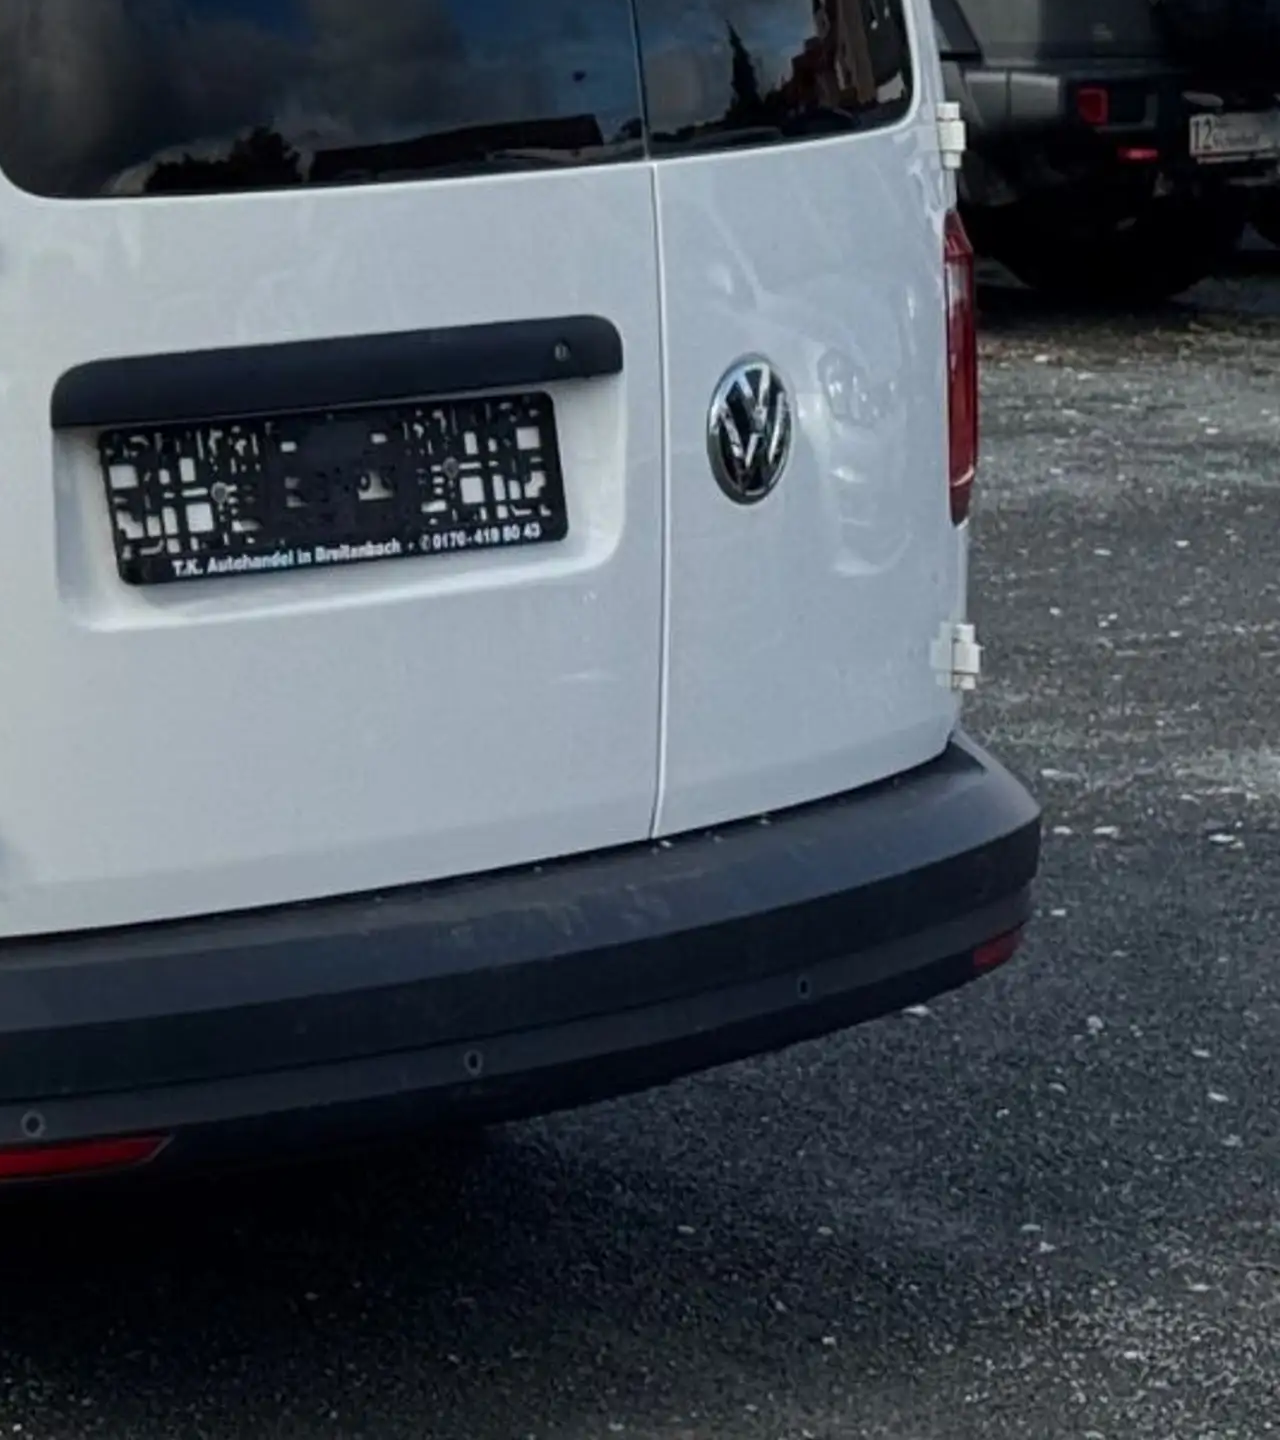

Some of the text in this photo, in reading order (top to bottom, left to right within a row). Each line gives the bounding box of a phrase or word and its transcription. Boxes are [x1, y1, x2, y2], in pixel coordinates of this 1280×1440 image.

[172, 559, 203, 576] T.K.
[207, 549, 293, 573] Autohandel
[297, 547, 311, 564] in
